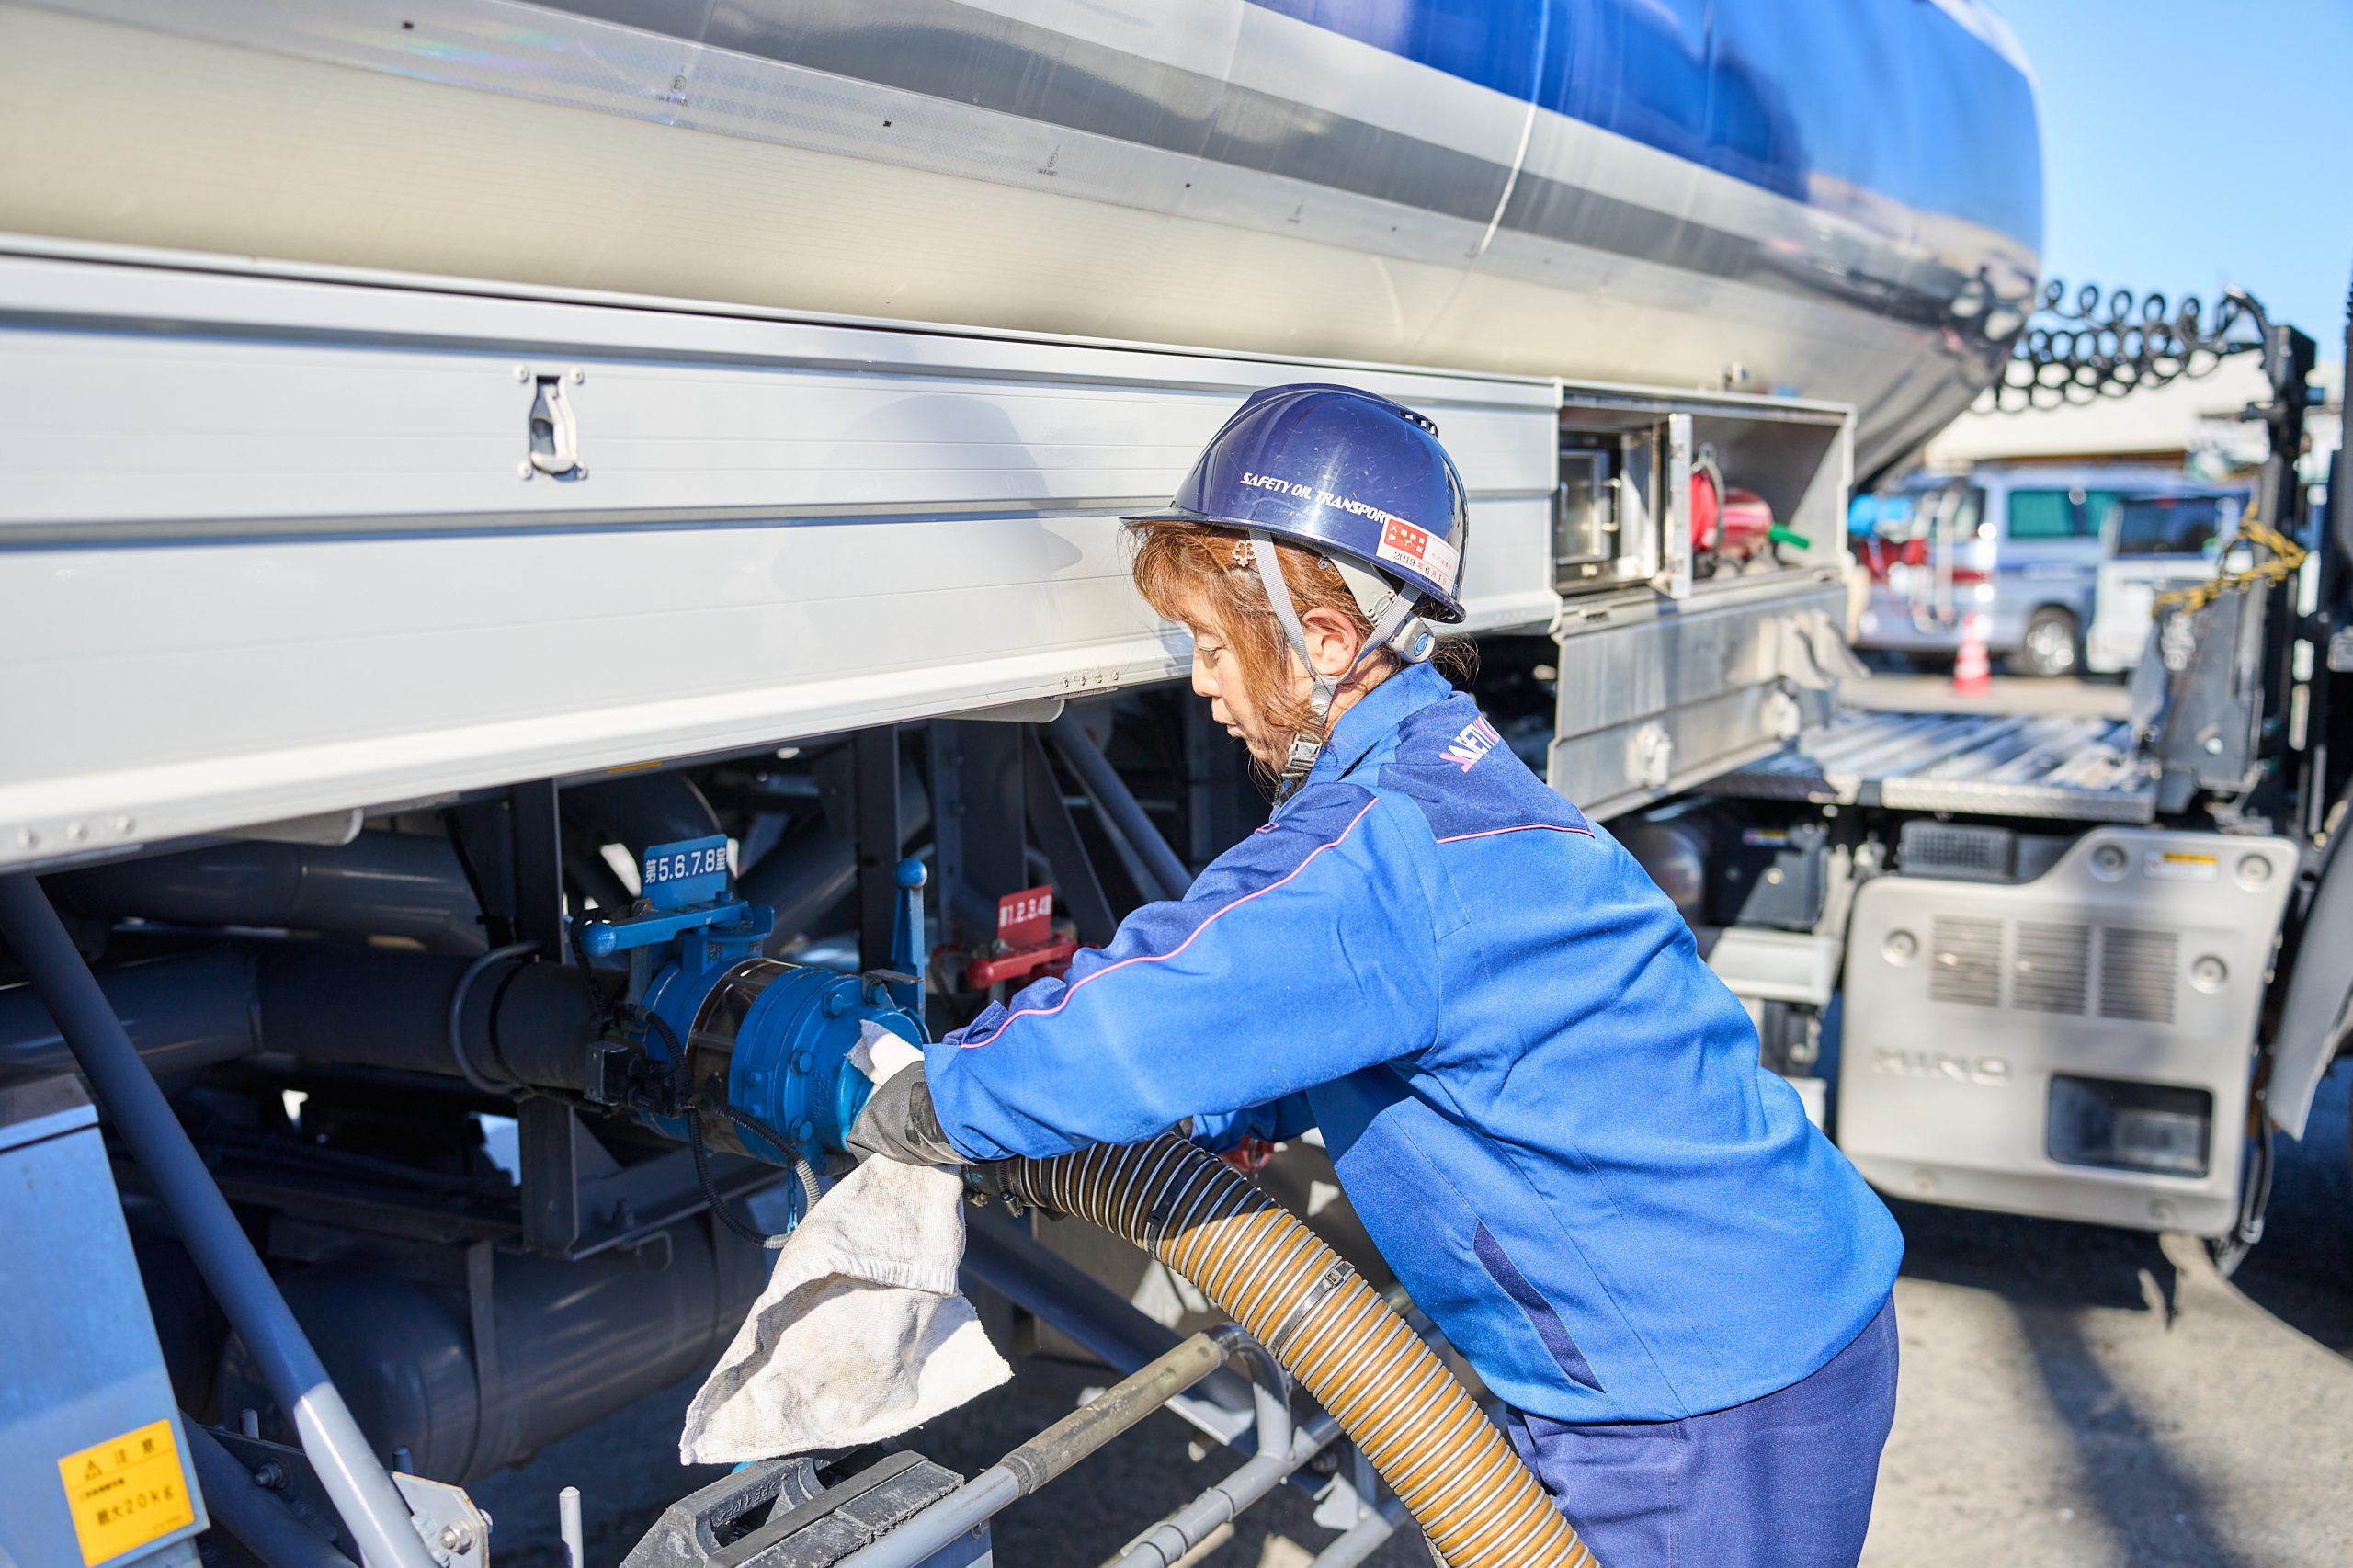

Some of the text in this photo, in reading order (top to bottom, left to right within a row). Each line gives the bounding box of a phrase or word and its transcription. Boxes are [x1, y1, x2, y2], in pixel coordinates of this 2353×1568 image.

[1240, 472, 1390, 524] SAFETY OIL TRANSPOR
[645, 846, 727, 884] 第5.6.7.8室
